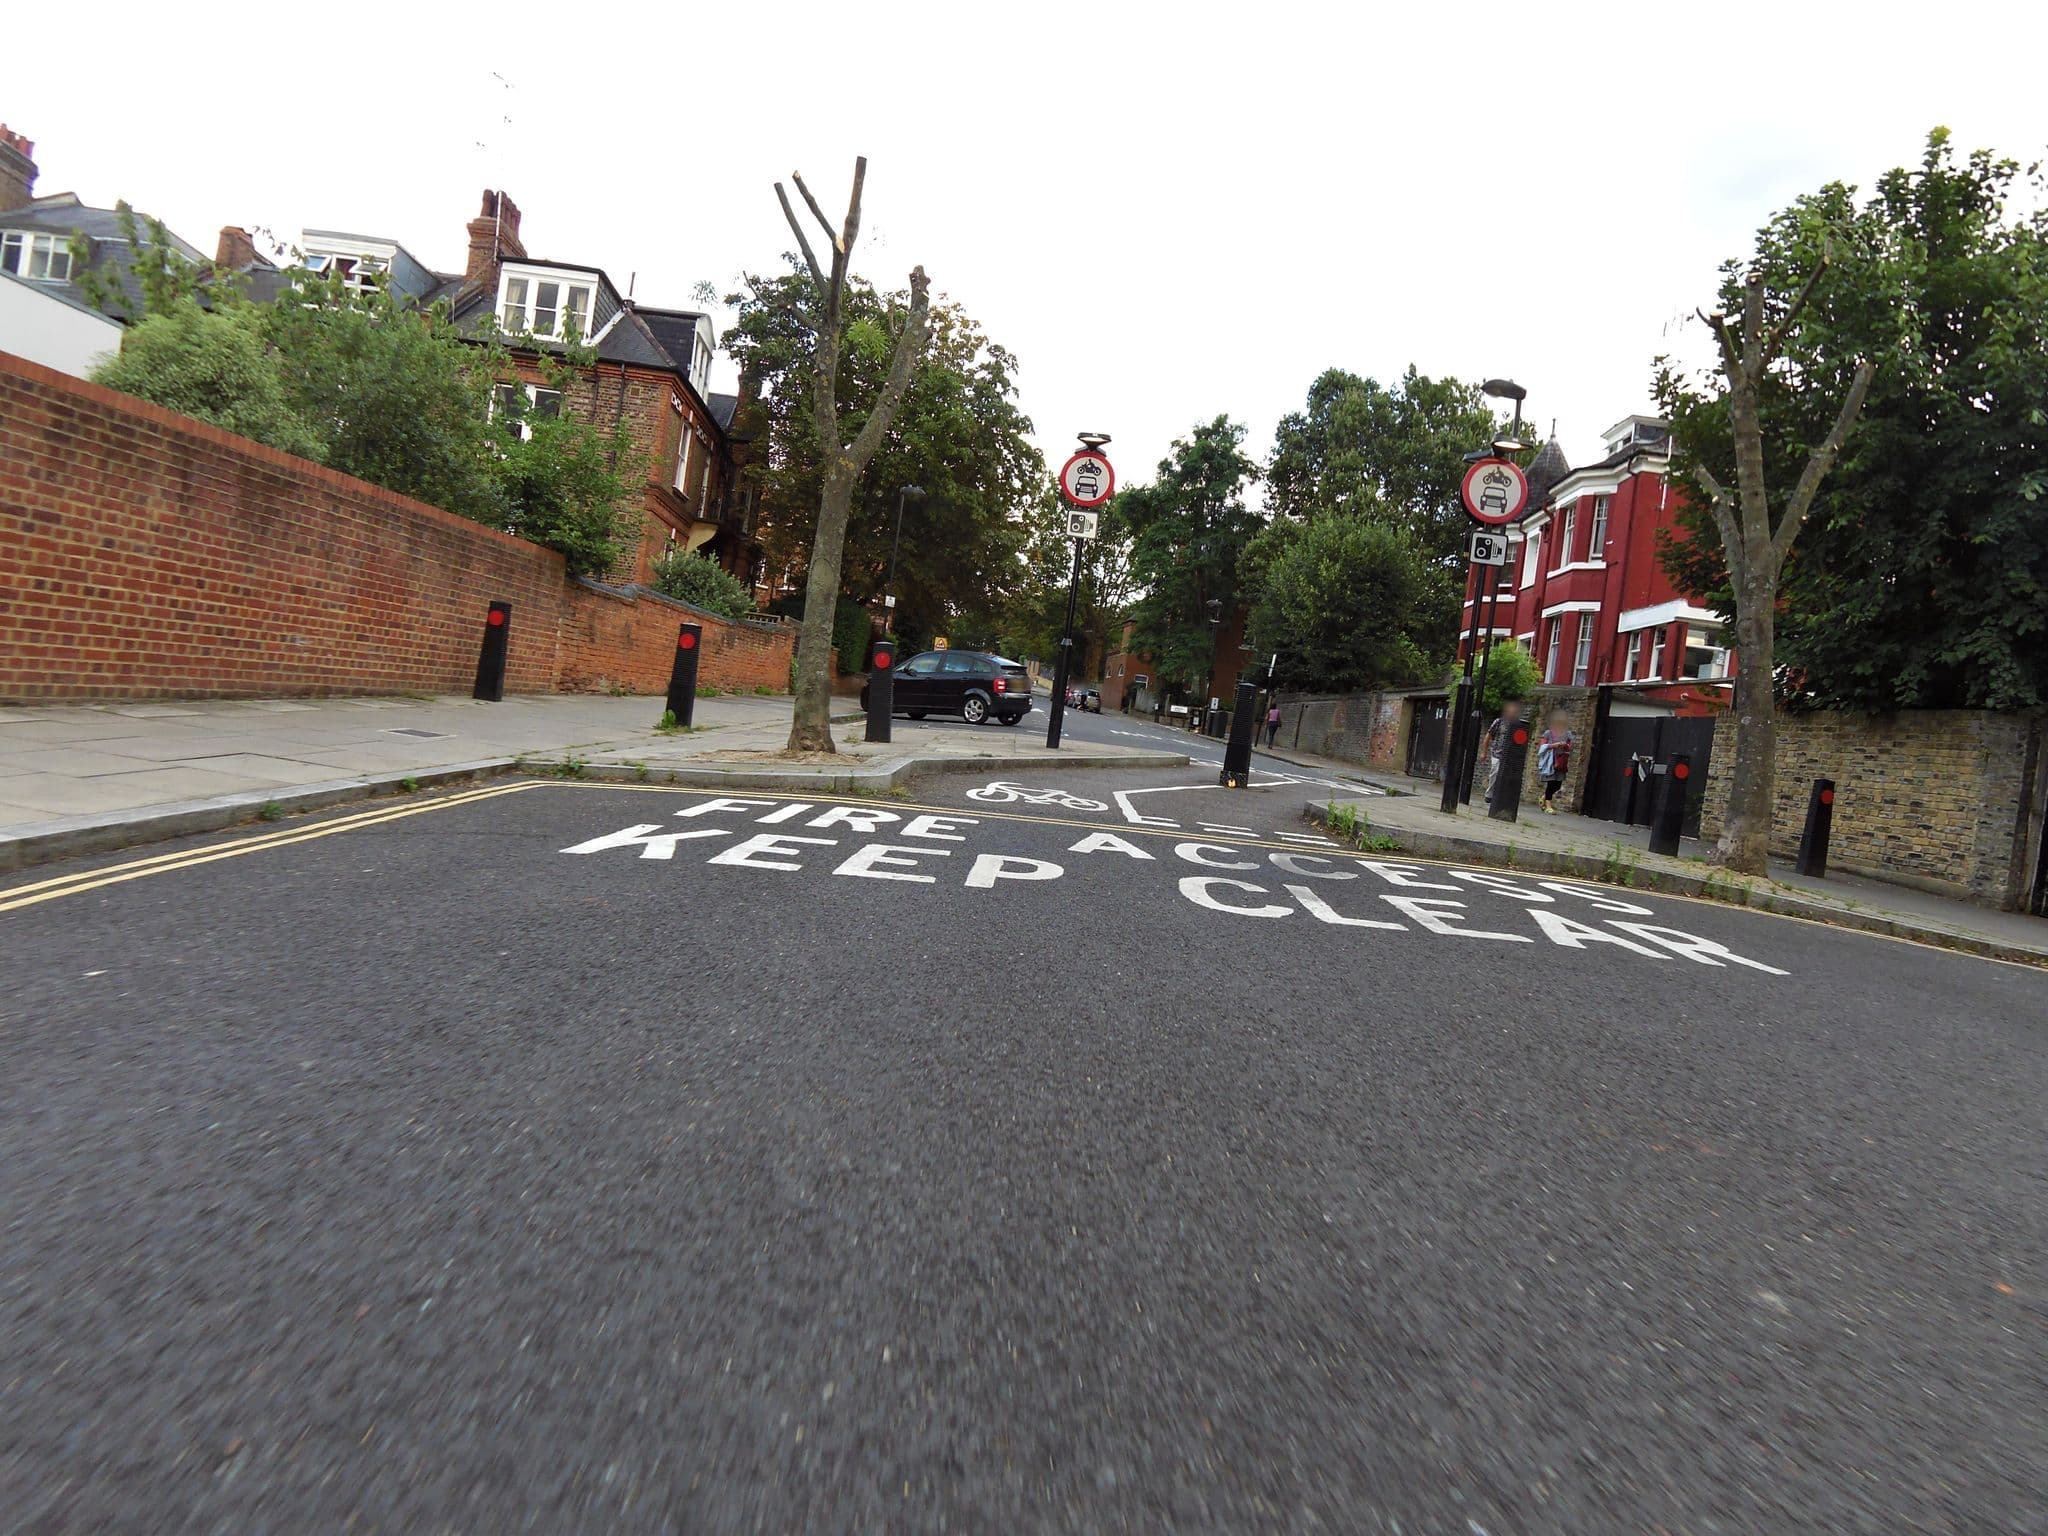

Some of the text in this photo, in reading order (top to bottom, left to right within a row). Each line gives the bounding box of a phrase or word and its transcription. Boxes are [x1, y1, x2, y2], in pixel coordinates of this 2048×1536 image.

[558, 824, 1791, 975] KEEP CLEAR
[673, 798, 1653, 916] FIRE ACCESS
